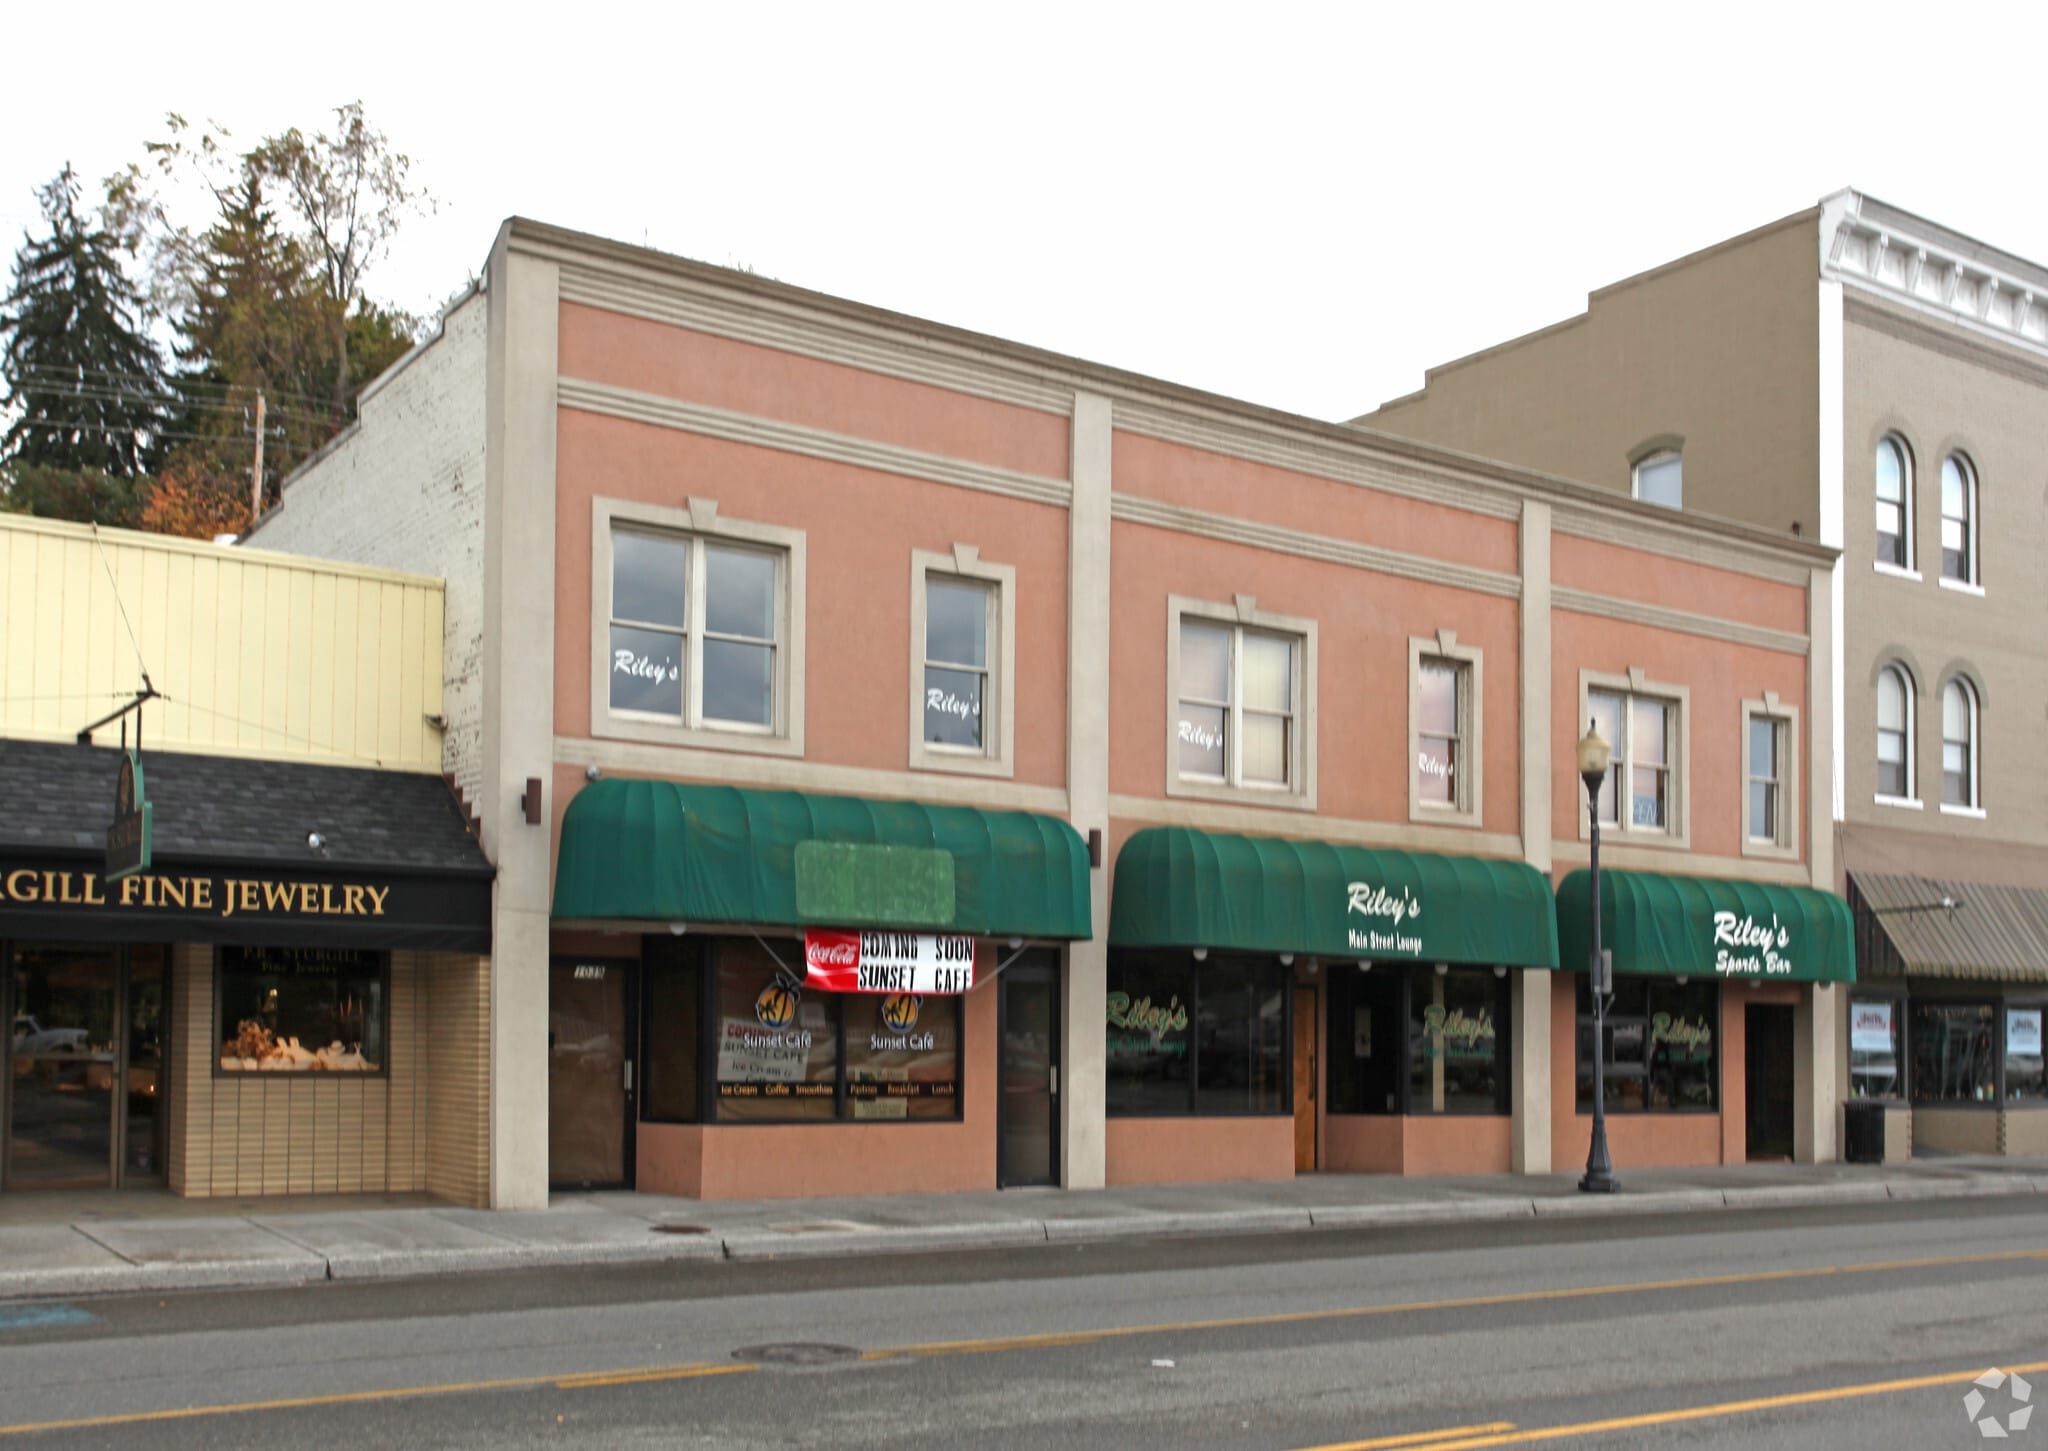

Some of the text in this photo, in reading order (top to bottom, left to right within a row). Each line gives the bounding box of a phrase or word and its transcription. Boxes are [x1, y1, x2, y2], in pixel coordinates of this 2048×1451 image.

[613, 648, 679, 686] Riley's
[927, 687, 980, 720] Riley's
[1178, 719, 1223, 752] Riley's
[1418, 752, 1454, 780] Riley's
[0, 869, 390, 918] GILL FINE JEWELRY
[1347, 881, 1421, 927] Riley's
[861, 933, 974, 962] COMING SOON
[1348, 928, 1422, 957] Main Street Lounge
[1713, 910, 1790, 957] Riley's
[859, 963, 917, 990] SUNSET
[1715, 949, 1792, 978] Sports Bar
[1106, 991, 1189, 1040] Riley's
[1423, 1006, 1496, 1049] Riley's
[744, 1031, 784, 1049] Sunset
[786, 1029, 812, 1049] Café
[870, 1031, 934, 1051] Sunset Café
[1651, 1012, 1711, 1052] Riley's
[721, 1084, 733, 1096] Ice
[733, 1083, 758, 1096] Cream
[765, 1081, 790, 1096] Coffee
[795, 1083, 834, 1096] Smoothies
[850, 1081, 954, 1096] Pastries Breakfast Lunch
